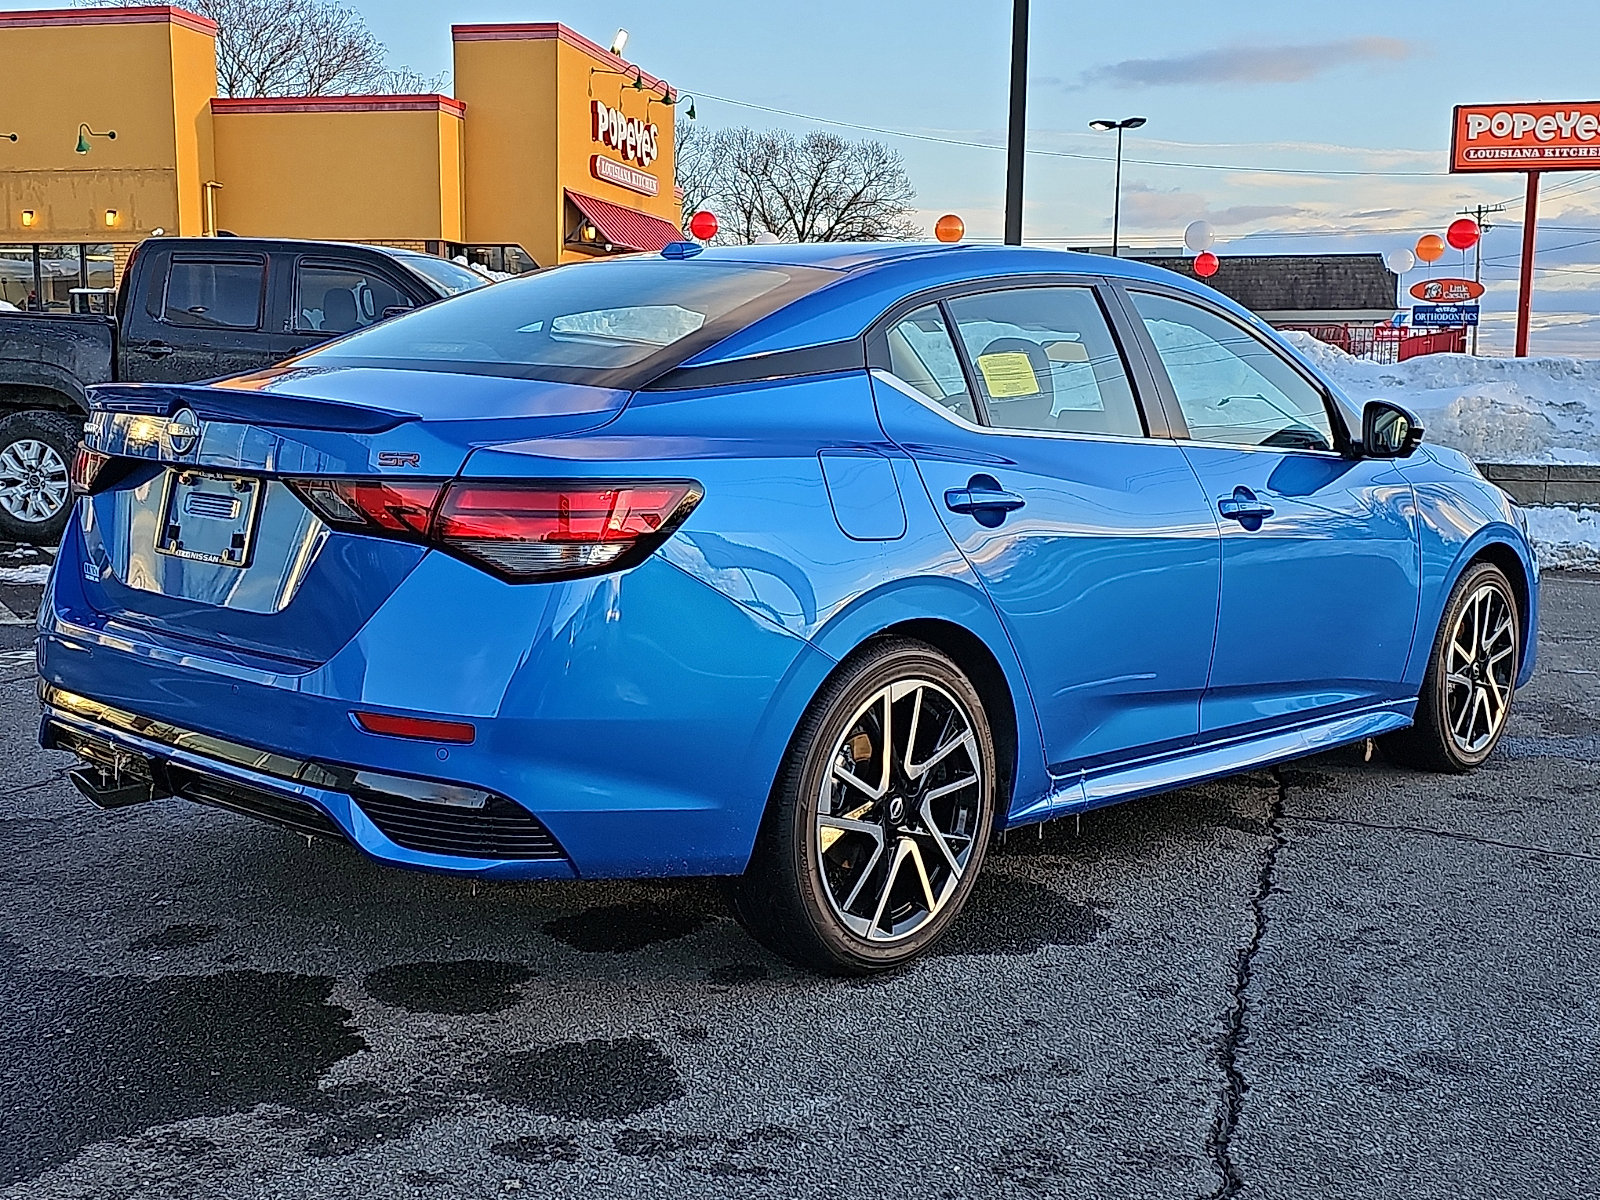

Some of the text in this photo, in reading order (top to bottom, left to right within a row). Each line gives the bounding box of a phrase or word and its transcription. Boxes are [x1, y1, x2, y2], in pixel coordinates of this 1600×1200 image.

[1467, 111, 1600, 141] POPeYe
[597, 100, 658, 167] POPeYeS
[1469, 147, 1600, 158] LOUISIANA KITCHE
[1449, 284, 1469, 293] Little
[1443, 291, 1471, 299] Caesars
[1414, 312, 1478, 321] ORTHODONTICS
[379, 452, 420, 468] SR
[190, 551, 219, 563] NISSAN
